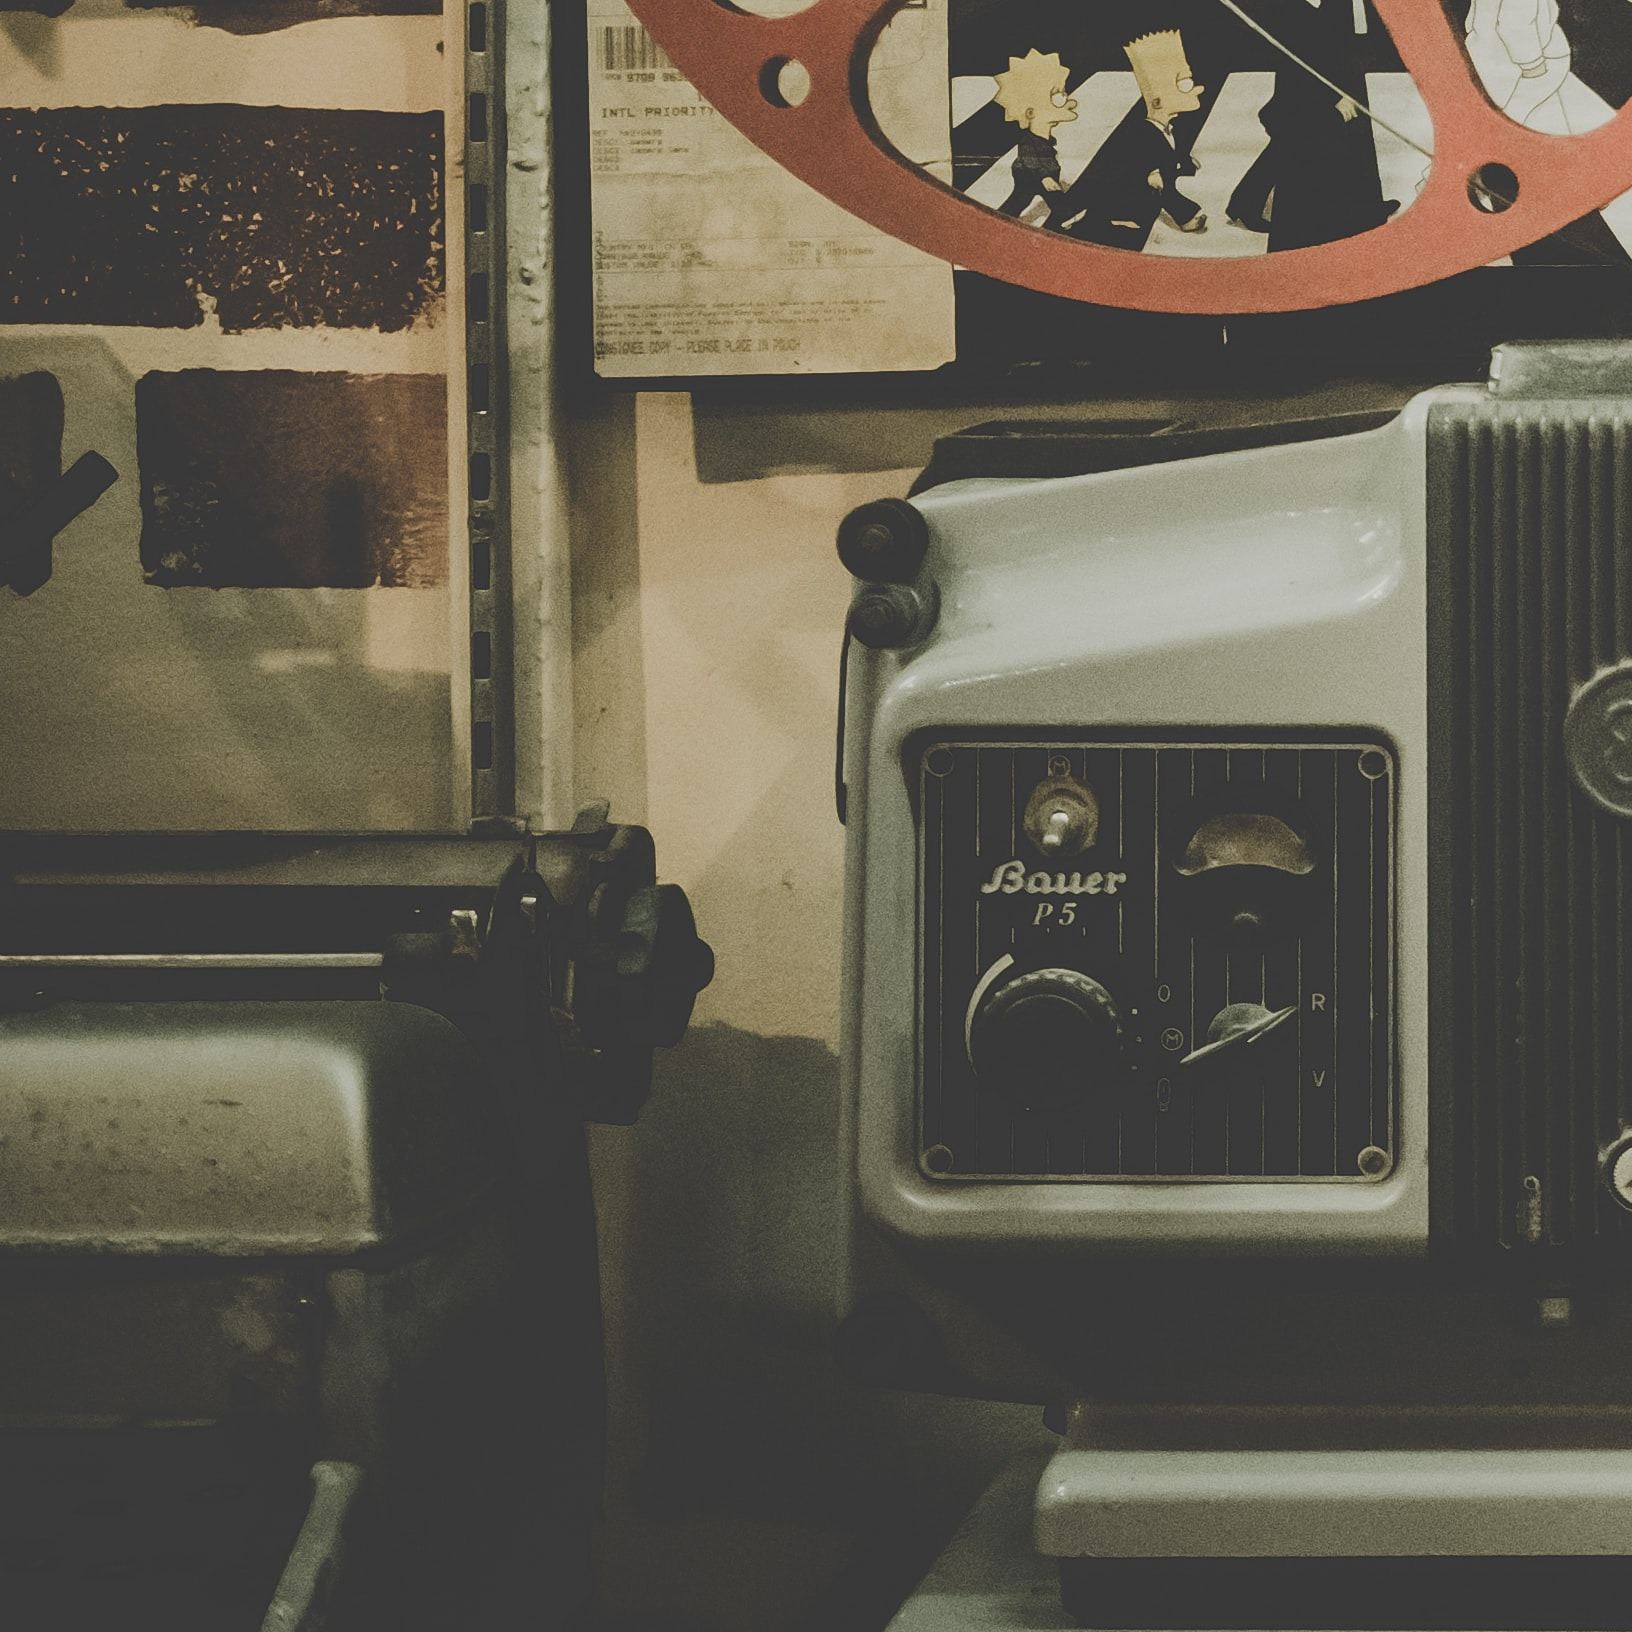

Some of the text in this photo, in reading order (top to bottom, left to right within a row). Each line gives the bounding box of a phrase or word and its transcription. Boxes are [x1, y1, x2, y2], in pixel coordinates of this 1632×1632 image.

[602, 108, 636, 118] INTL
[980, 859, 1127, 895] Bauer
[1311, 993, 1326, 1011] R
[1311, 1069, 1326, 1087] V
